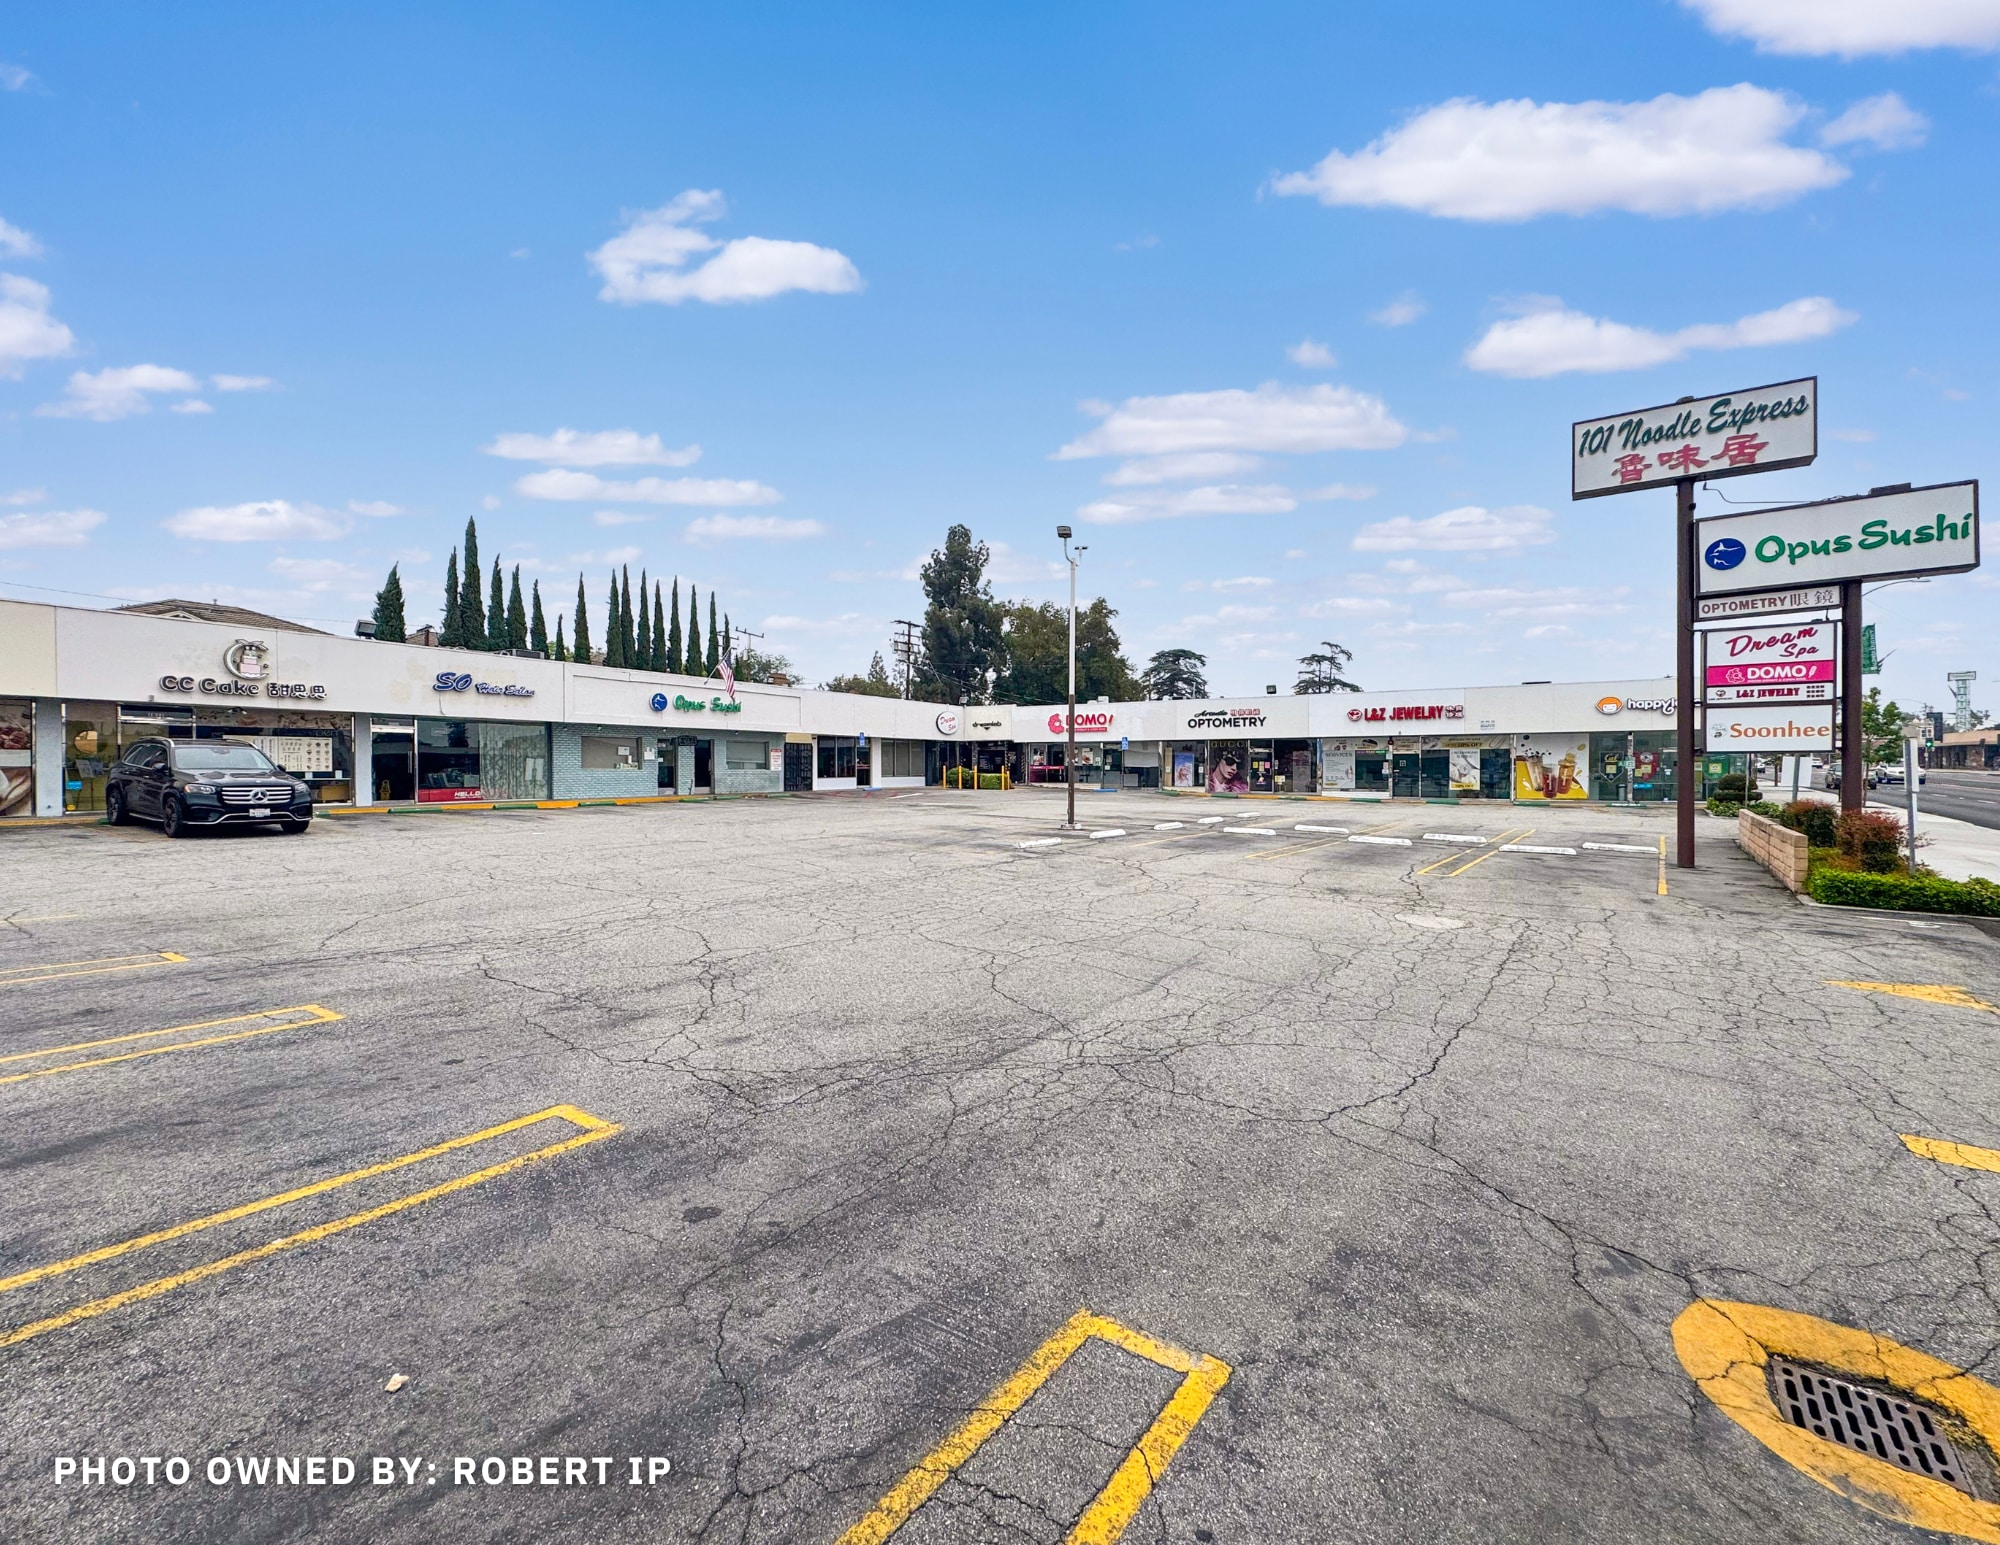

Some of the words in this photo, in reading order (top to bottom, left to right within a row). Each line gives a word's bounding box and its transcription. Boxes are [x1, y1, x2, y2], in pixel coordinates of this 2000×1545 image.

[1578, 423, 1615, 457] 101
[1617, 409, 1702, 451] Noodle
[1706, 395, 1810, 434] Express
[1611, 432, 1769, 484] 魯味居
[1755, 535, 1852, 565] Opus
[1858, 512, 1973, 550] Sushi
[1701, 595, 1787, 615] OPTOMETRY
[1725, 627, 1818, 657] Dream
[1779, 643, 1819, 658] Spa
[159, 675, 195, 693] CC
[199, 677, 260, 697] Cake
[267, 682, 328, 700] 甜思思
[433, 672, 472, 692] SO
[475, 682, 504, 695] Hair
[503, 685, 535, 697] Salon
[1736, 689, 1755, 698] L&Z
[1757, 688, 1800, 698] JEWELRY
[673, 694, 706, 712] Opus
[710, 697, 742, 713] Sushi
[1364, 708, 1386, 721] L&Z
[1389, 705, 1444, 720] JEWELRY
[1187, 717, 1267, 728] OPTOMETRY
[1729, 720, 1830, 738] Soonhee
[1211, 740, 1248, 748] GUCCI
